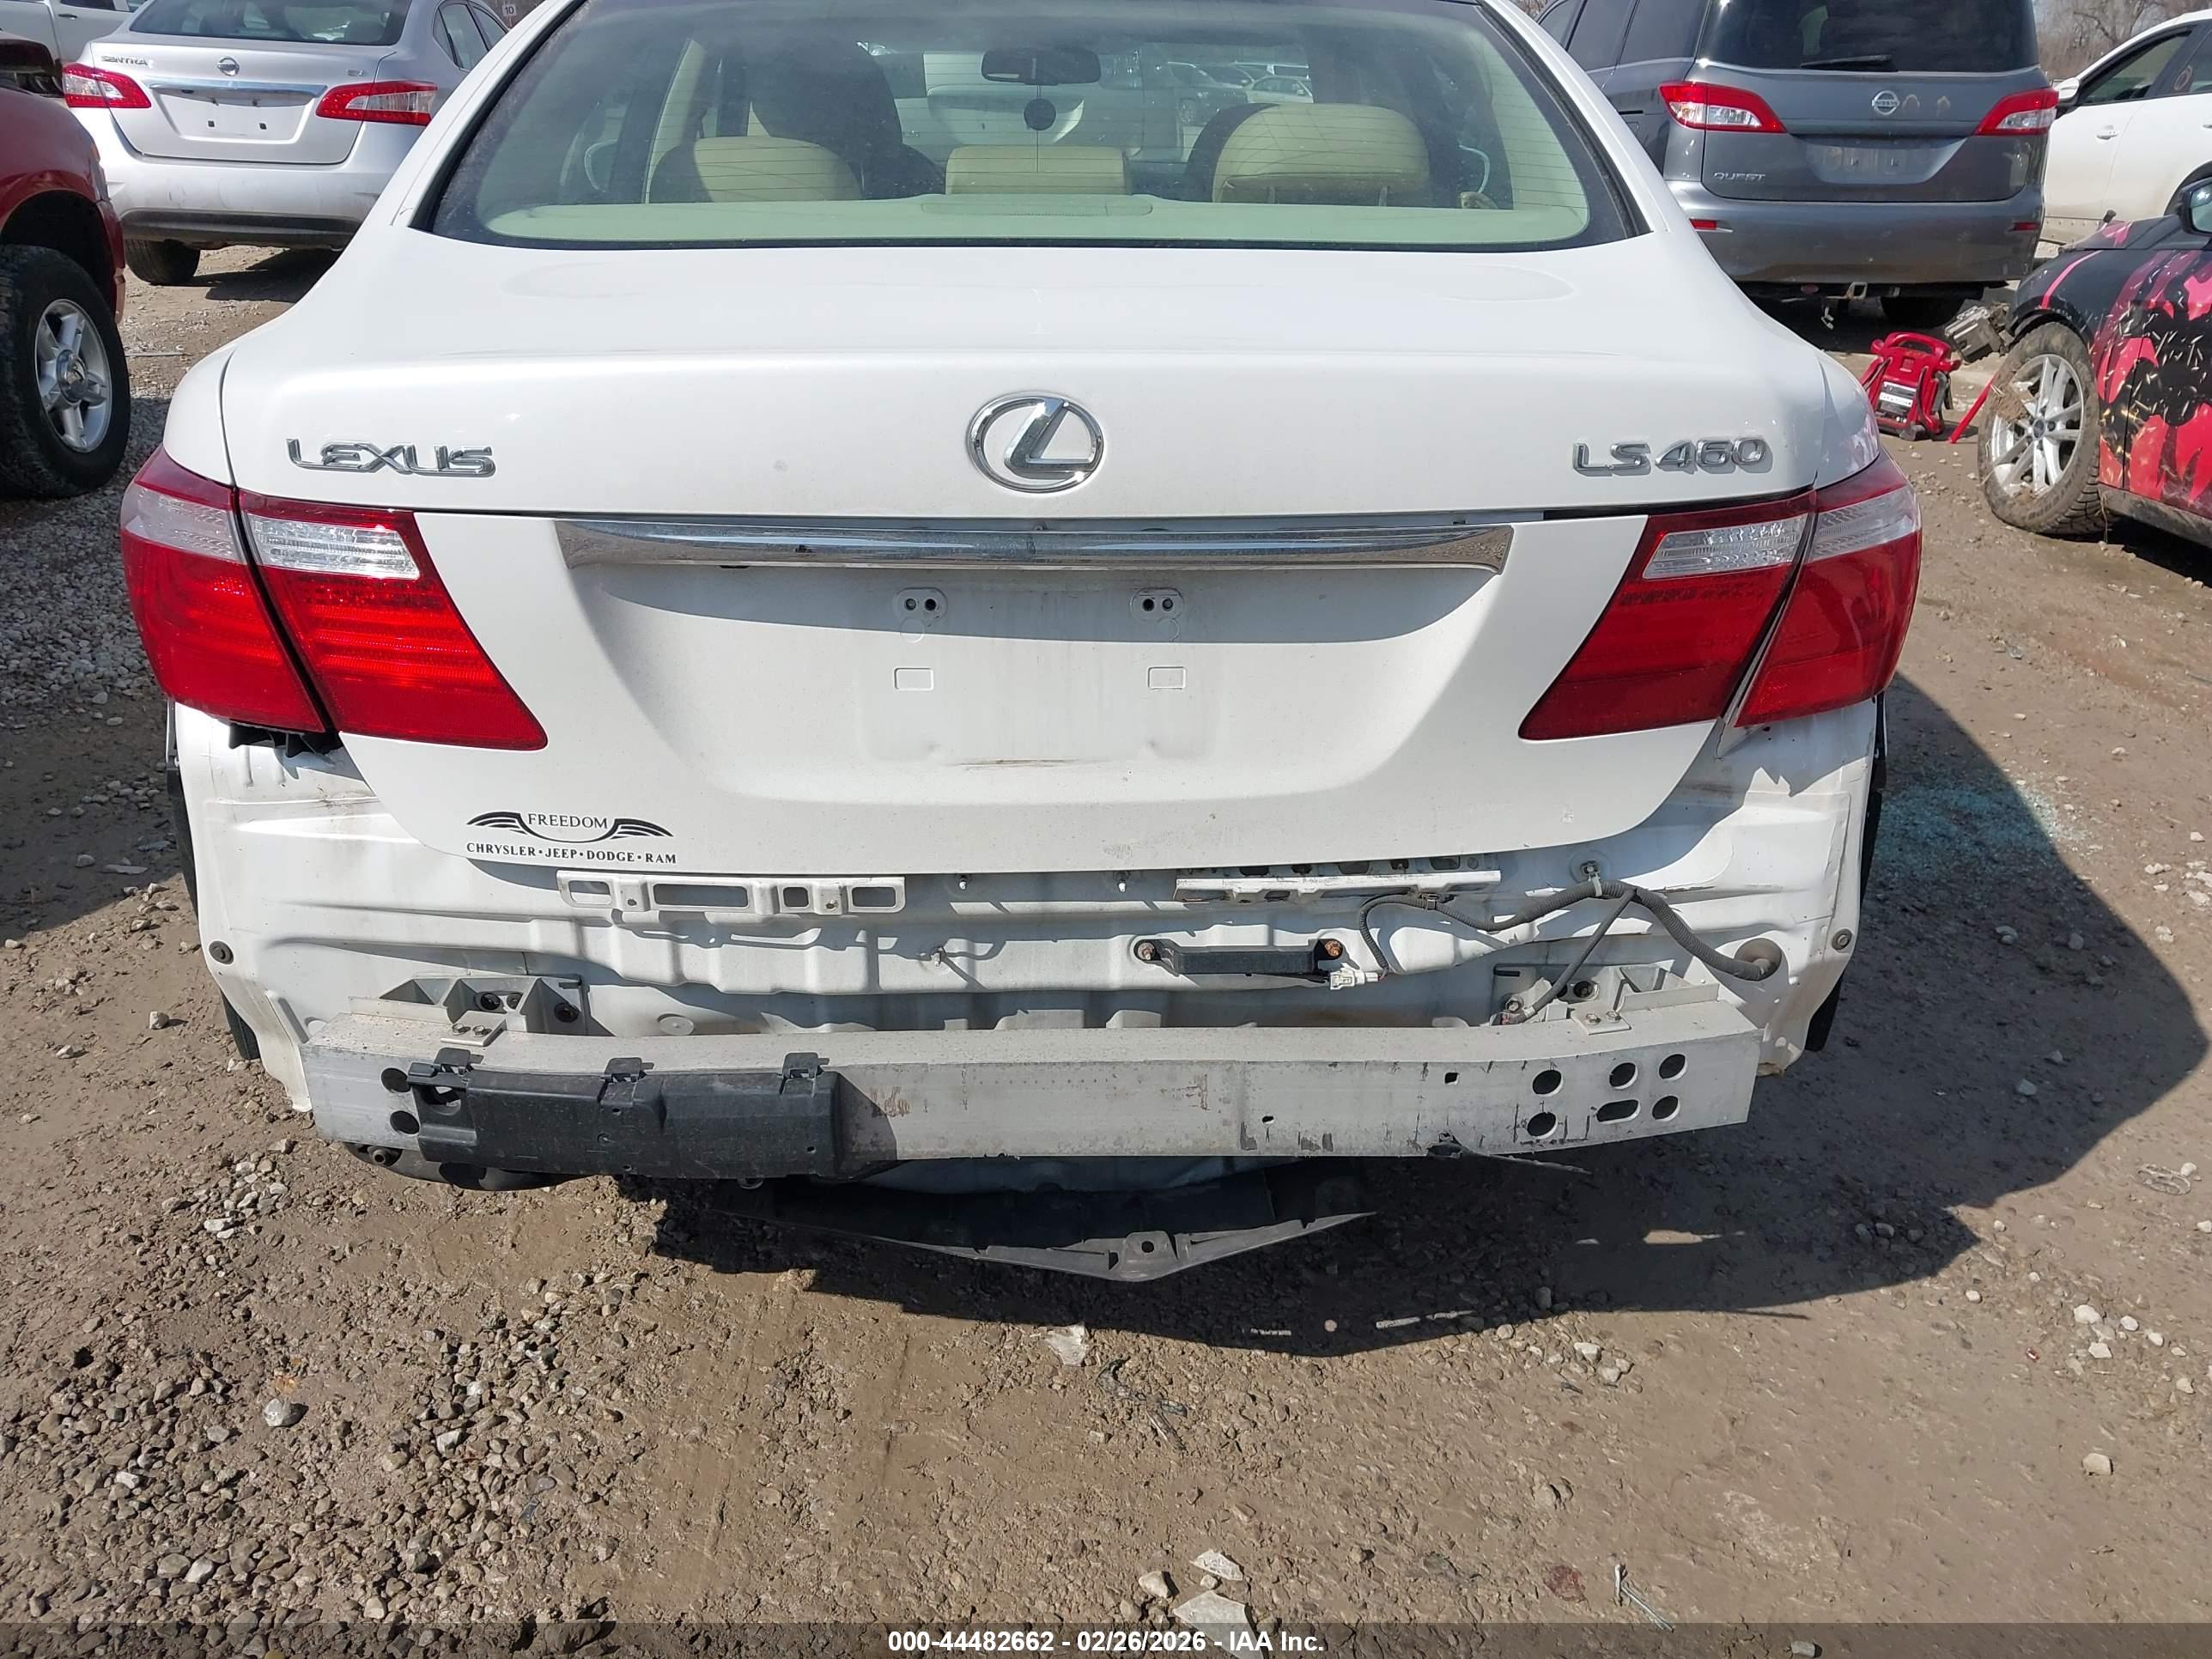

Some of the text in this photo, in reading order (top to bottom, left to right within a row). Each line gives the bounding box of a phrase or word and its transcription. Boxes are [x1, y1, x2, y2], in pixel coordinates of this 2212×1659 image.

[506, 6, 514, 15] 10
[1714, 172, 1766, 181] QUEST
[286, 438, 496, 477] LEXUS
[527, 813, 609, 829] FREEDOM
[466, 842, 678, 864] CHRYSLER JEEP DODGE RAM
